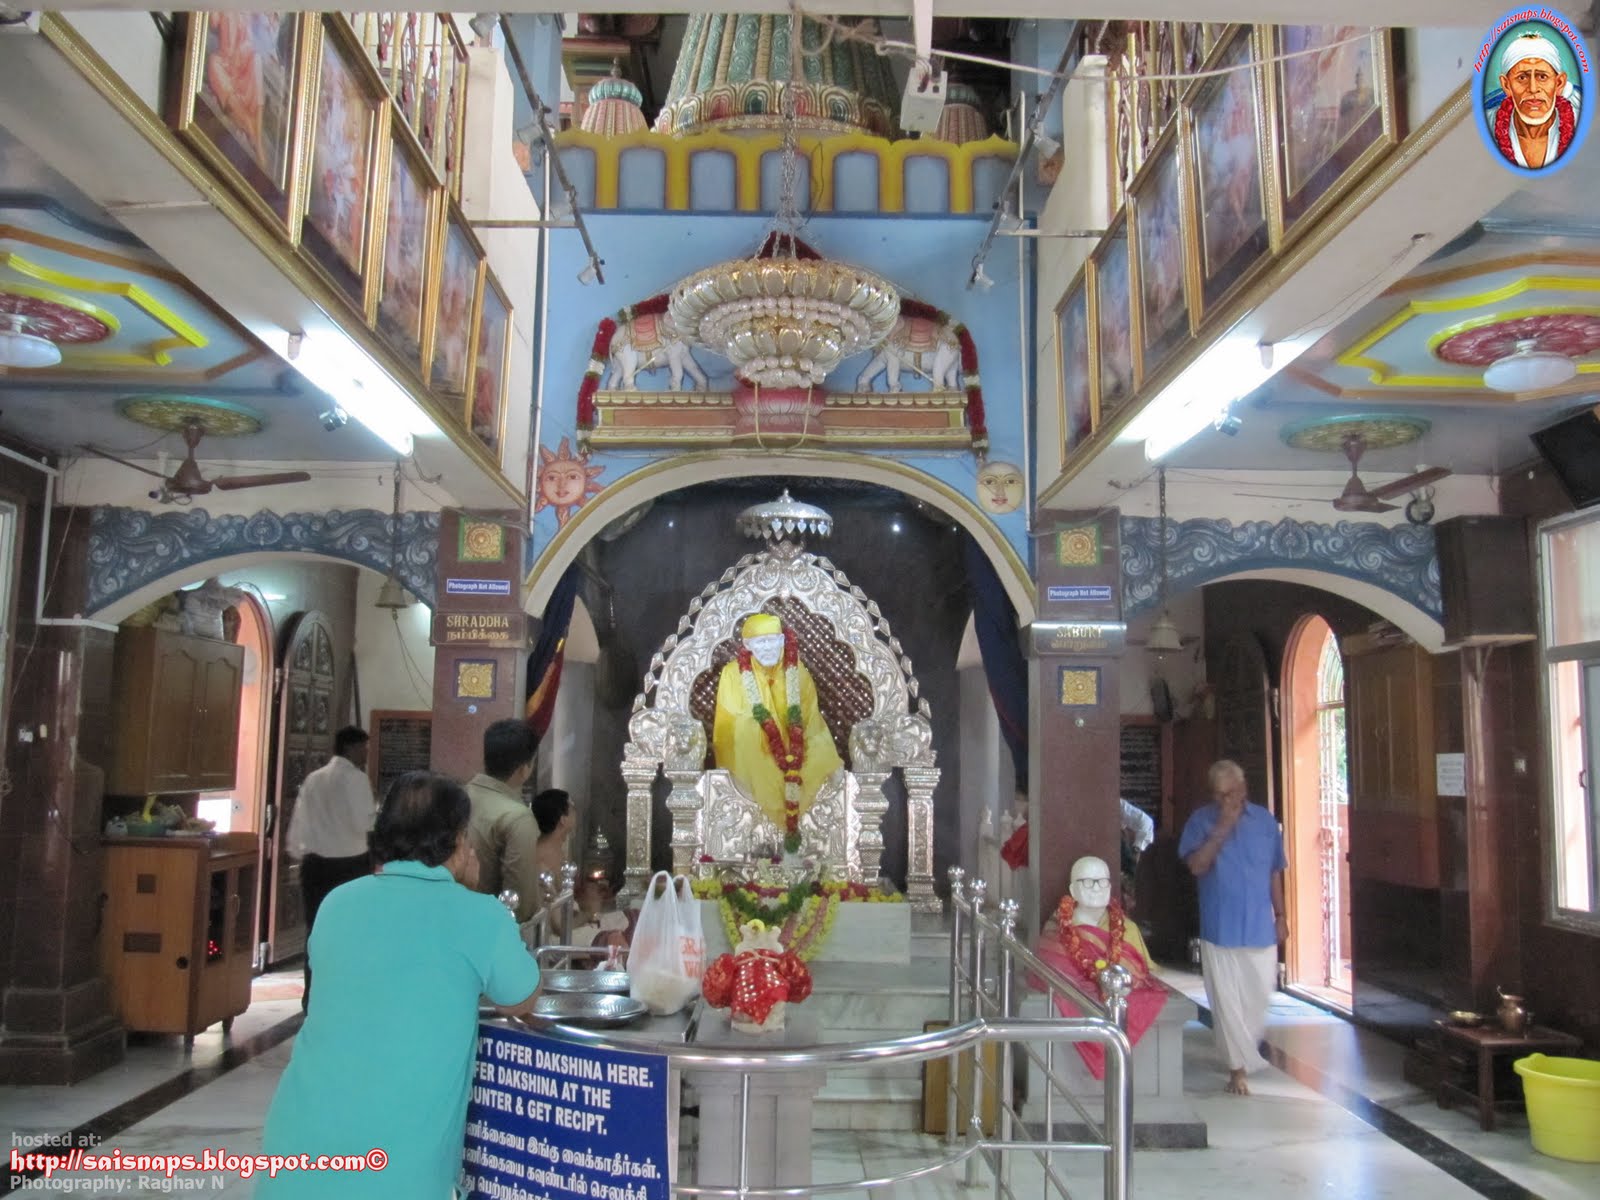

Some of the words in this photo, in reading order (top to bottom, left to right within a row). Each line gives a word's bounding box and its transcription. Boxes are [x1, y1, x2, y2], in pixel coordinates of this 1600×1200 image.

[446, 615, 509, 628] SHRADDHA
[473, 1060, 495, 1083] FER
[498, 1065, 558, 1098] DAKSHINA
[561, 1081, 579, 1103] AT
[581, 1086, 612, 1109] THE
[477, 1036, 493, 1057] N'T
[496, 1040, 533, 1066] OFFER
[535, 1049, 603, 1082] DAKSHINA
[606, 1063, 654, 1088] HERE.
[469, 1085, 512, 1113] OUNTER
[515, 1096, 524, 1116] &
[527, 1099, 552, 1124] GET
[555, 1106, 608, 1136] RECIPT.
[526, 1136, 560, 1164] இங்கு
